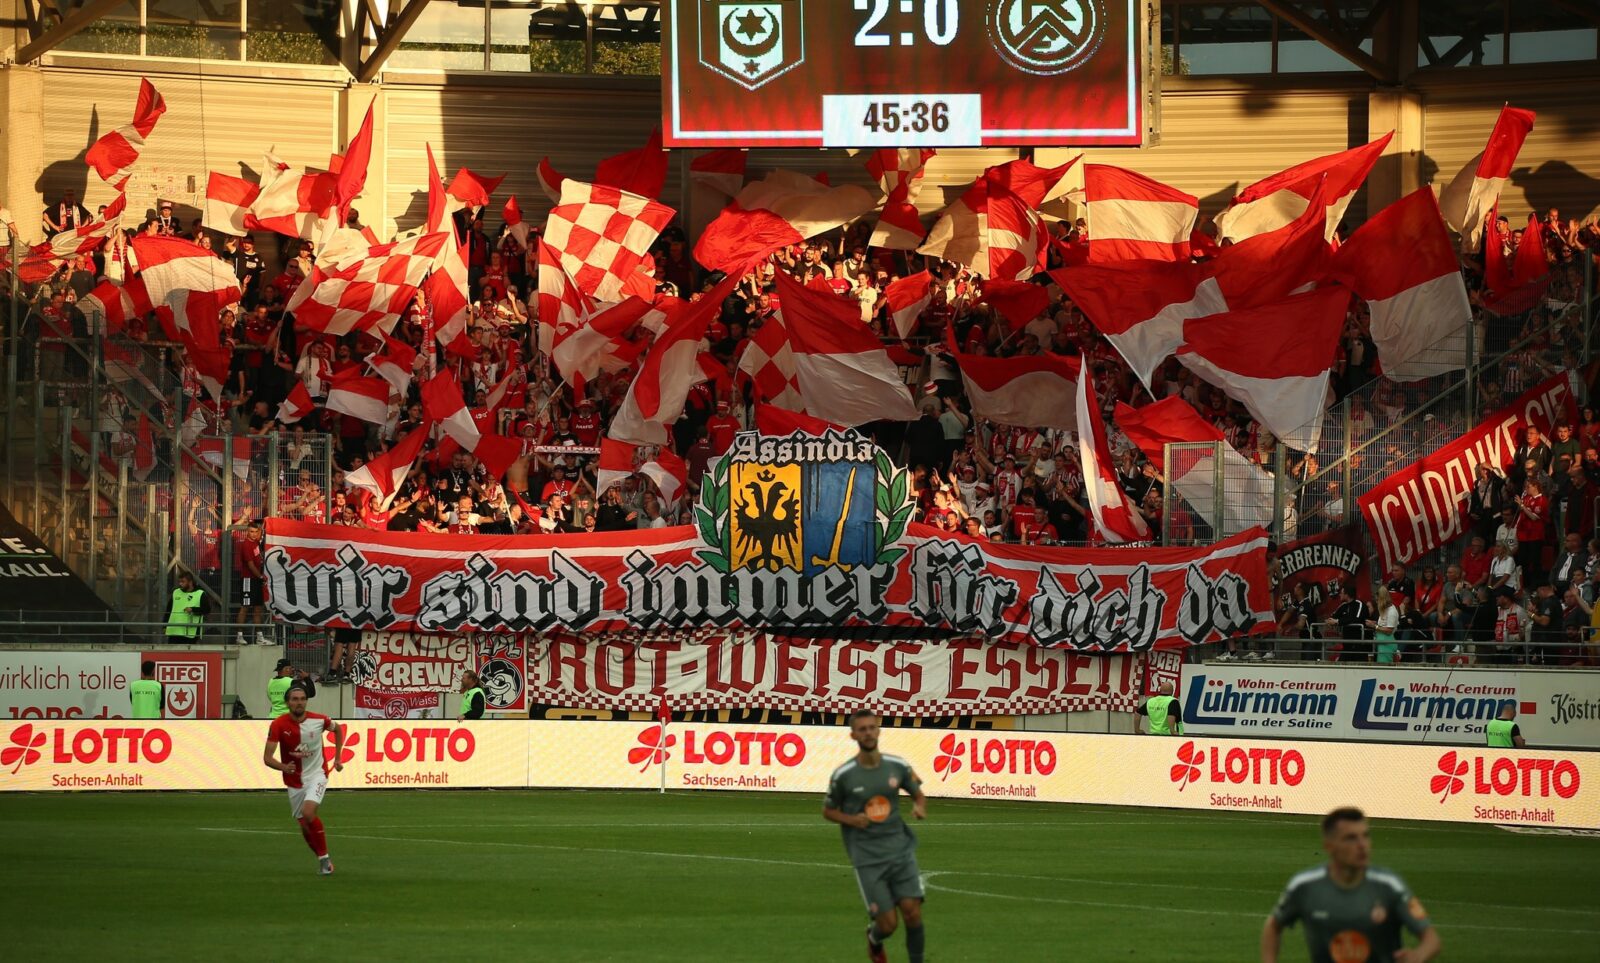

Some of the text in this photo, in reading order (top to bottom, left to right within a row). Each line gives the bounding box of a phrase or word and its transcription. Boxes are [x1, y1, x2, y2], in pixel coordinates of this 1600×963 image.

[854, 0, 959, 46] 2:0
[862, 102, 950, 134] 45:36
[731, 431, 877, 463] Assindia
[265, 539, 1256, 649] wir sind immer für dich da
[79, 665, 126, 689] tolle
[162, 667, 201, 680] HFC
[378, 662, 452, 687] CREW
[1237, 678, 1337, 691] Wohn-Centrum
[1183, 674, 1338, 726] Lührmann
[1409, 682, 1516, 695] Wohn-Centrum
[410, 696, 438, 706] Weiss
[1262, 717, 1286, 727] der
[1288, 718, 1333, 729] Saline
[1413, 724, 1431, 732] an
[1436, 723, 1460, 732] der
[53, 727, 172, 764] LOTTO
[365, 727, 476, 762] LOTTO
[684, 730, 806, 767] LOTTO
[970, 738, 1057, 776] LOTTO
[1210, 746, 1306, 786] LOTTO
[52, 773, 144, 788] Sachsen-Anhalt
[364, 771, 449, 785] Sachsen-Anhalt
[683, 773, 777, 788] Sachsen-Anhalt
[1474, 756, 1580, 799] LOTTO
[970, 782, 1036, 798] Sachsen-Anhalt
[1210, 792, 1282, 810] Sachsen-Anhalt
[1474, 805, 1555, 823] Sachsen-Anhalt
